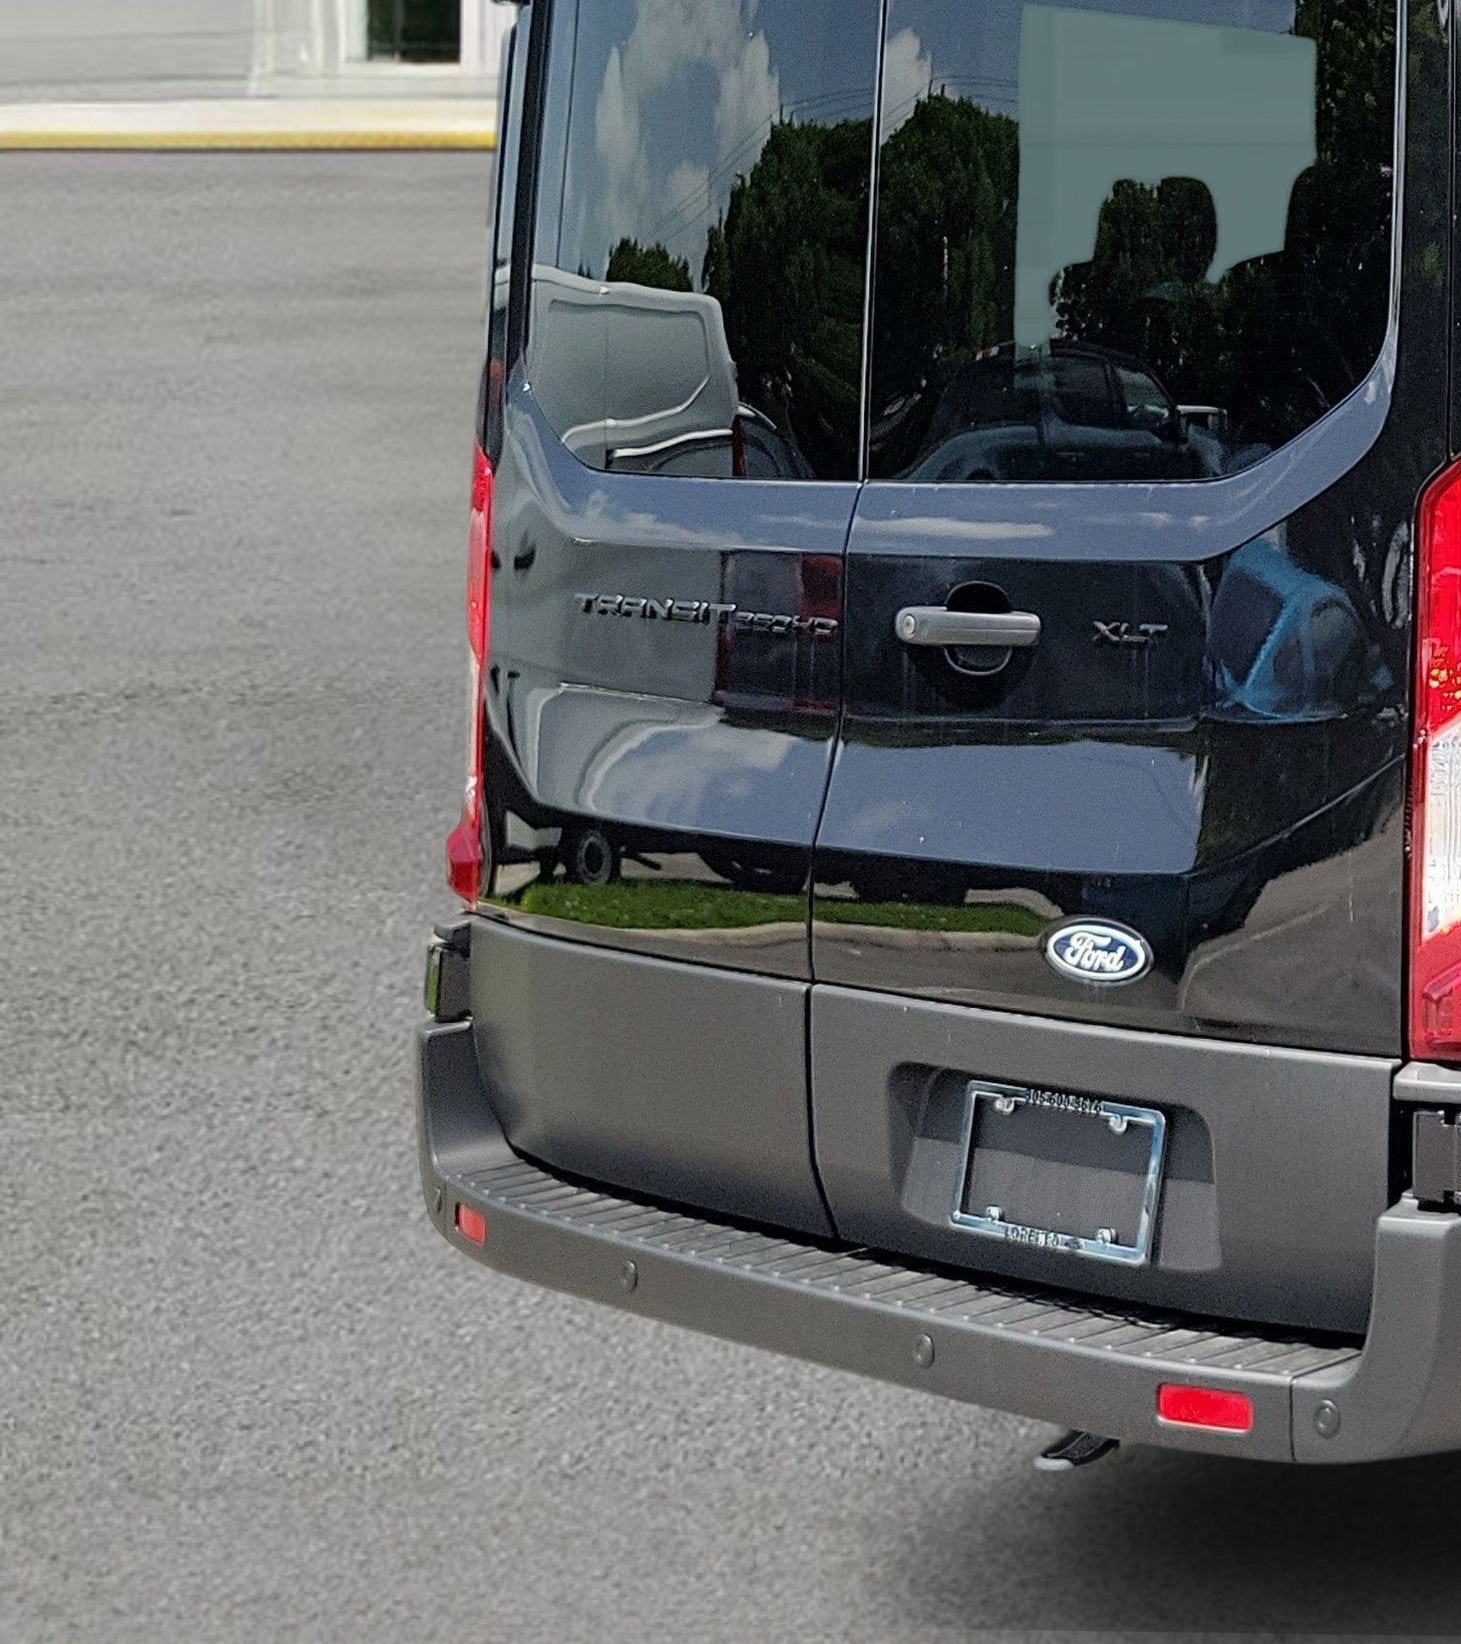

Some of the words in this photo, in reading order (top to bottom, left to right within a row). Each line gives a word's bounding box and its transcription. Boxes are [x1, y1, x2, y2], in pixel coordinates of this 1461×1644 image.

[574, 592, 737, 626] TRANSIT
[1092, 621, 1169, 643] XLT
[1063, 930, 1126, 972] Ford
